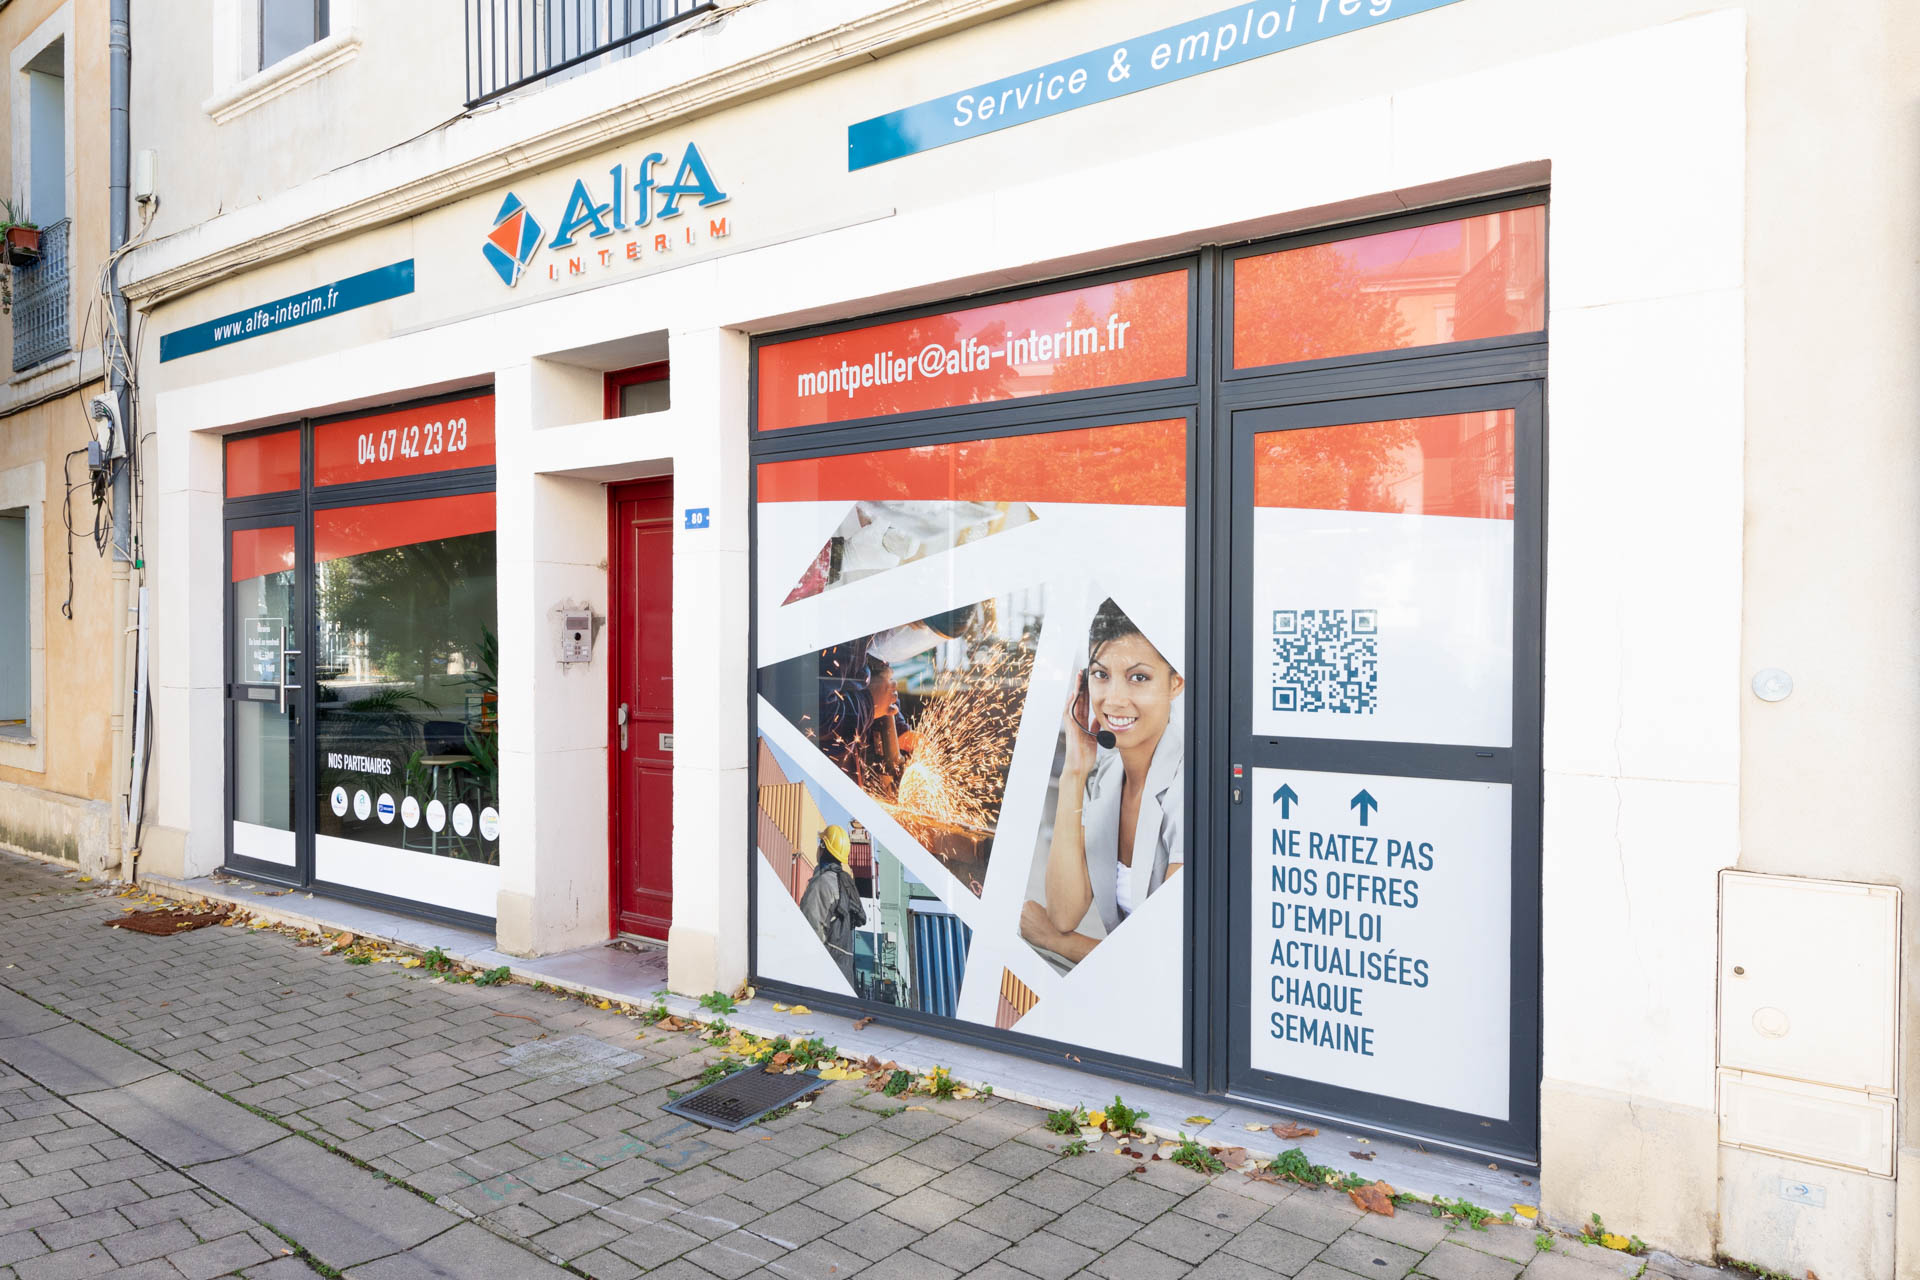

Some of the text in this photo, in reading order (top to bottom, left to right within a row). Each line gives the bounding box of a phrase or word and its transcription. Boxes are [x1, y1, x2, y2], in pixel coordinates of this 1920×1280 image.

[953, 66, 1088, 127] Service
[1107, 47, 1131, 83] &
[1150, 0, 1298, 70] emploi
[549, 217, 729, 281] INTERIM
[213, 288, 339, 342] www.alfa-interim.fr
[797, 313, 1131, 399] montpellier@alfa-interim.fr
[358, 417, 467, 465] 04 67 42 23 23
[328, 752, 392, 776] NOS PARTENAIRES
[1272, 828, 1434, 872] NE RATEZ PAS
[1272, 864, 1419, 909] NOS OFFRES
[1271, 901, 1382, 943] D'EMPLOI
[1270, 938, 1429, 988] ACTUALISÉES
[1271, 975, 1363, 1017] CHAQUE
[1270, 1011, 1375, 1057] SEMAINE
